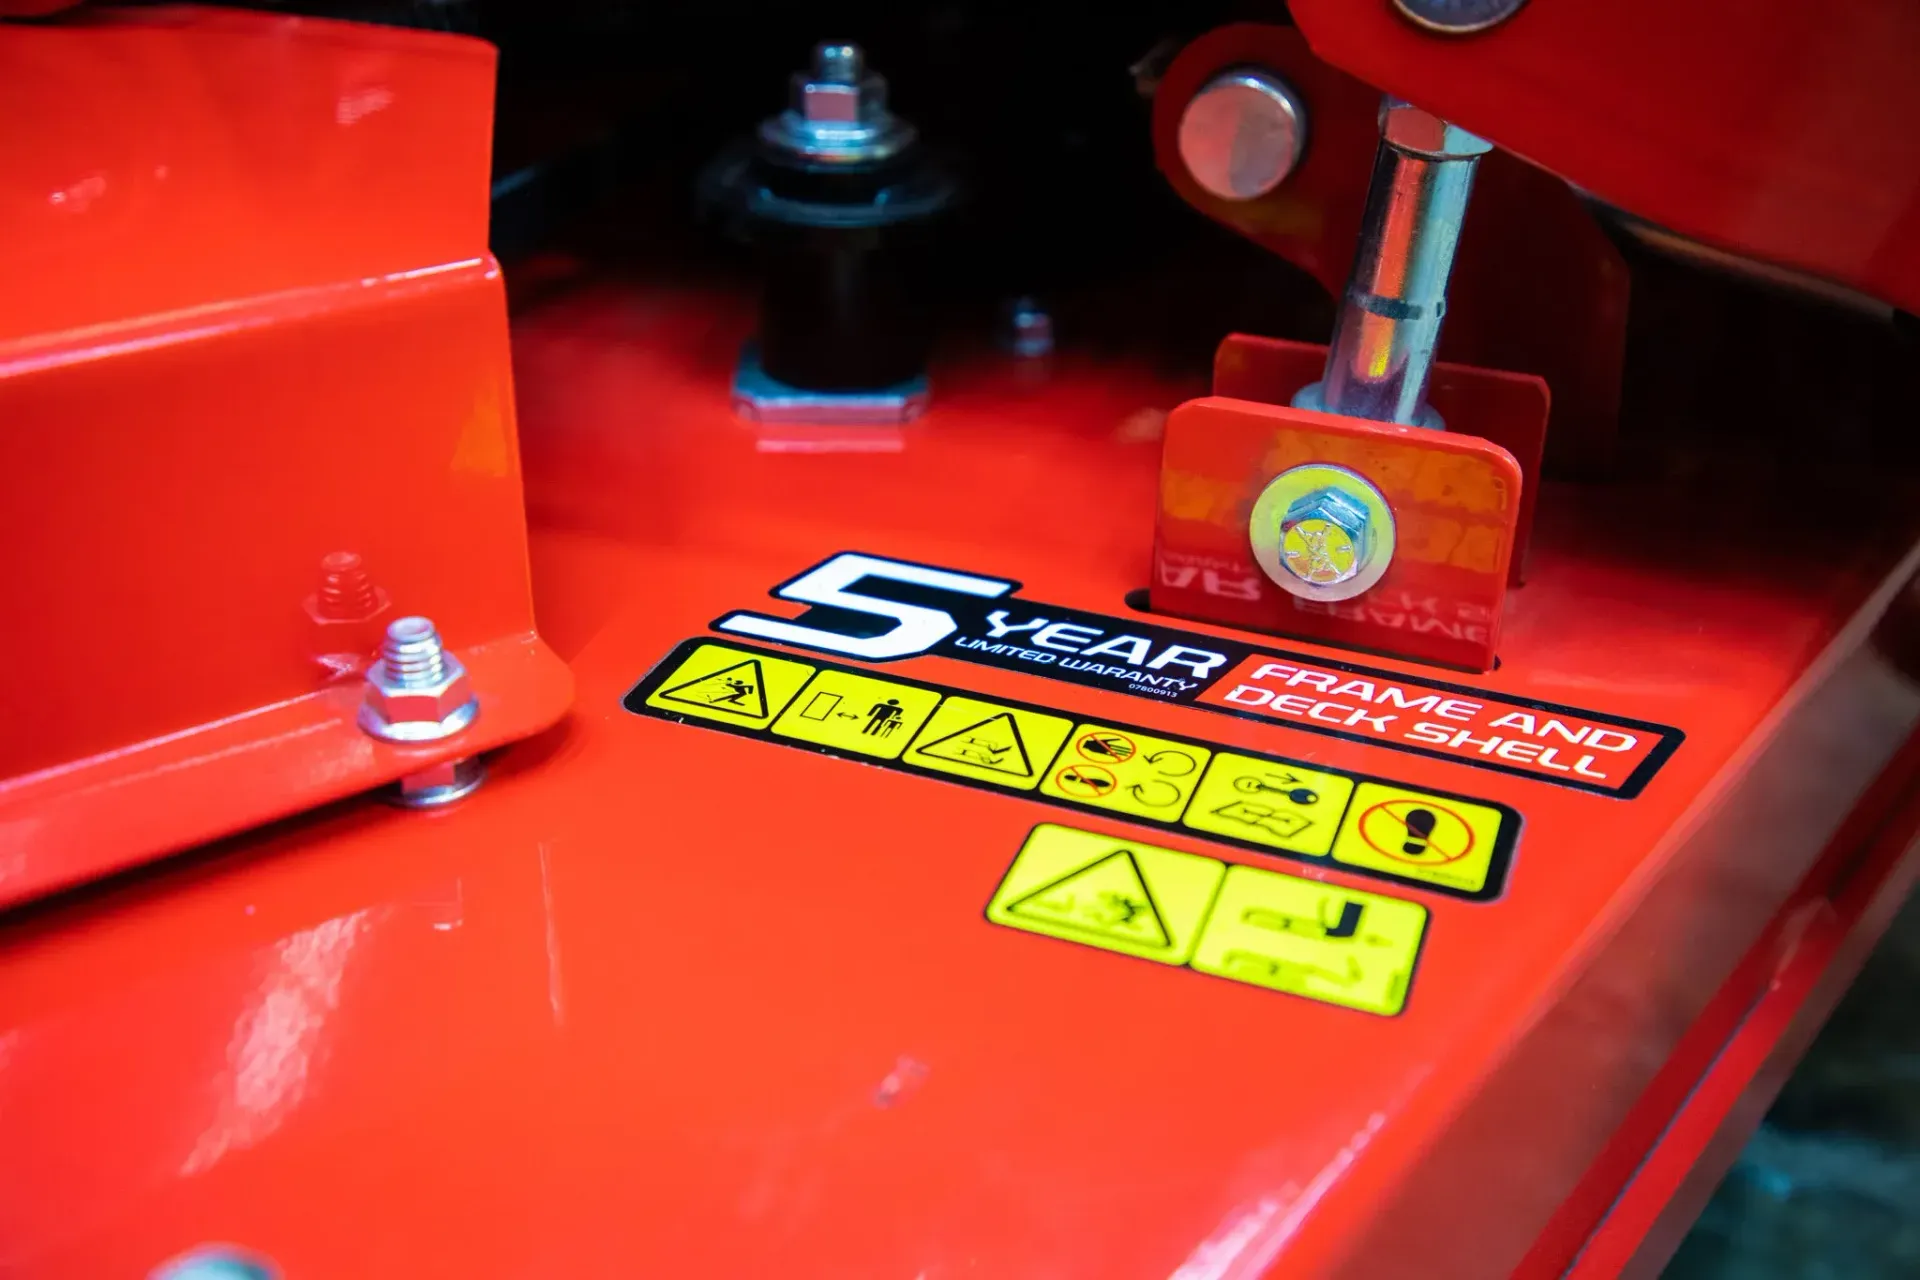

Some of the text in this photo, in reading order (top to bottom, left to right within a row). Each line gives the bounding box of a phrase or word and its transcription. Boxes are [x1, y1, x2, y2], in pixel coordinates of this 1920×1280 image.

[719, 554, 1227, 678] 5 YEAR
[954, 636, 1198, 691] LIMITED WARANTY
[1128, 683, 1178, 698] 07800913
[1250, 662, 1638, 752] FRAME AND
[1223, 684, 1608, 778] DECK SHELL
